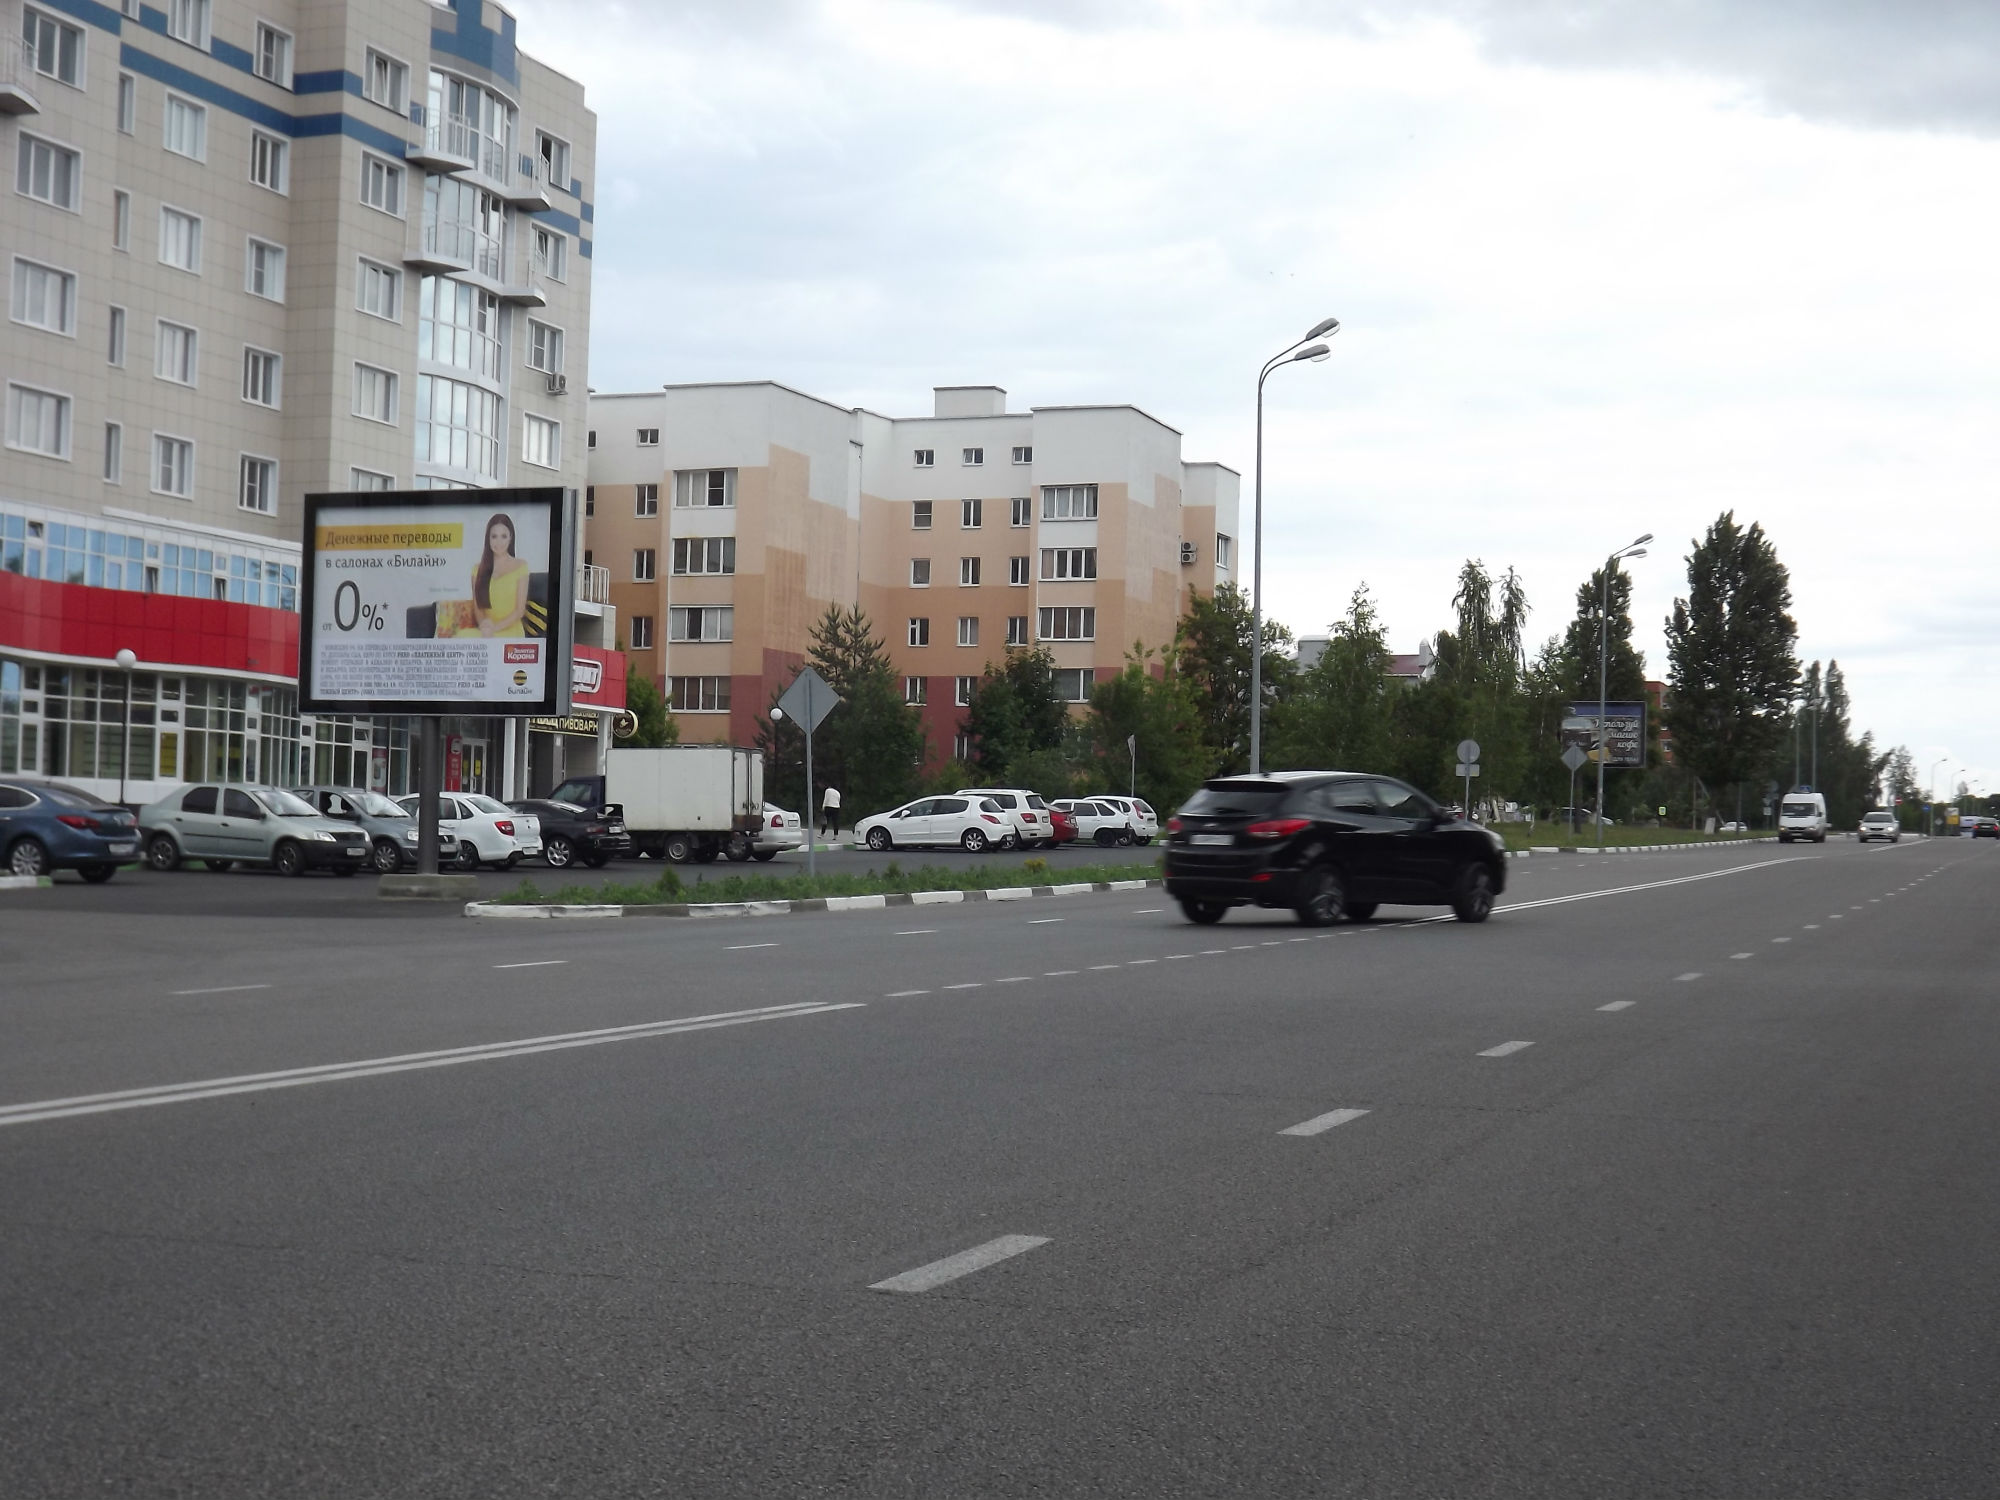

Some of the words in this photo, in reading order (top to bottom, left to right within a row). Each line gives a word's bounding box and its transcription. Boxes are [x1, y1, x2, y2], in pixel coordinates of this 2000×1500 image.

[325, 531, 389, 547] Денежные
[393, 531, 452, 547] переводы
[325, 558, 332, 568] в
[335, 557, 383, 568] салонах
[386, 554, 447, 568] «Билайн»
[322, 622, 332, 631] от
[507, 651, 535, 660] Корона
[507, 687, 533, 695] билайн
